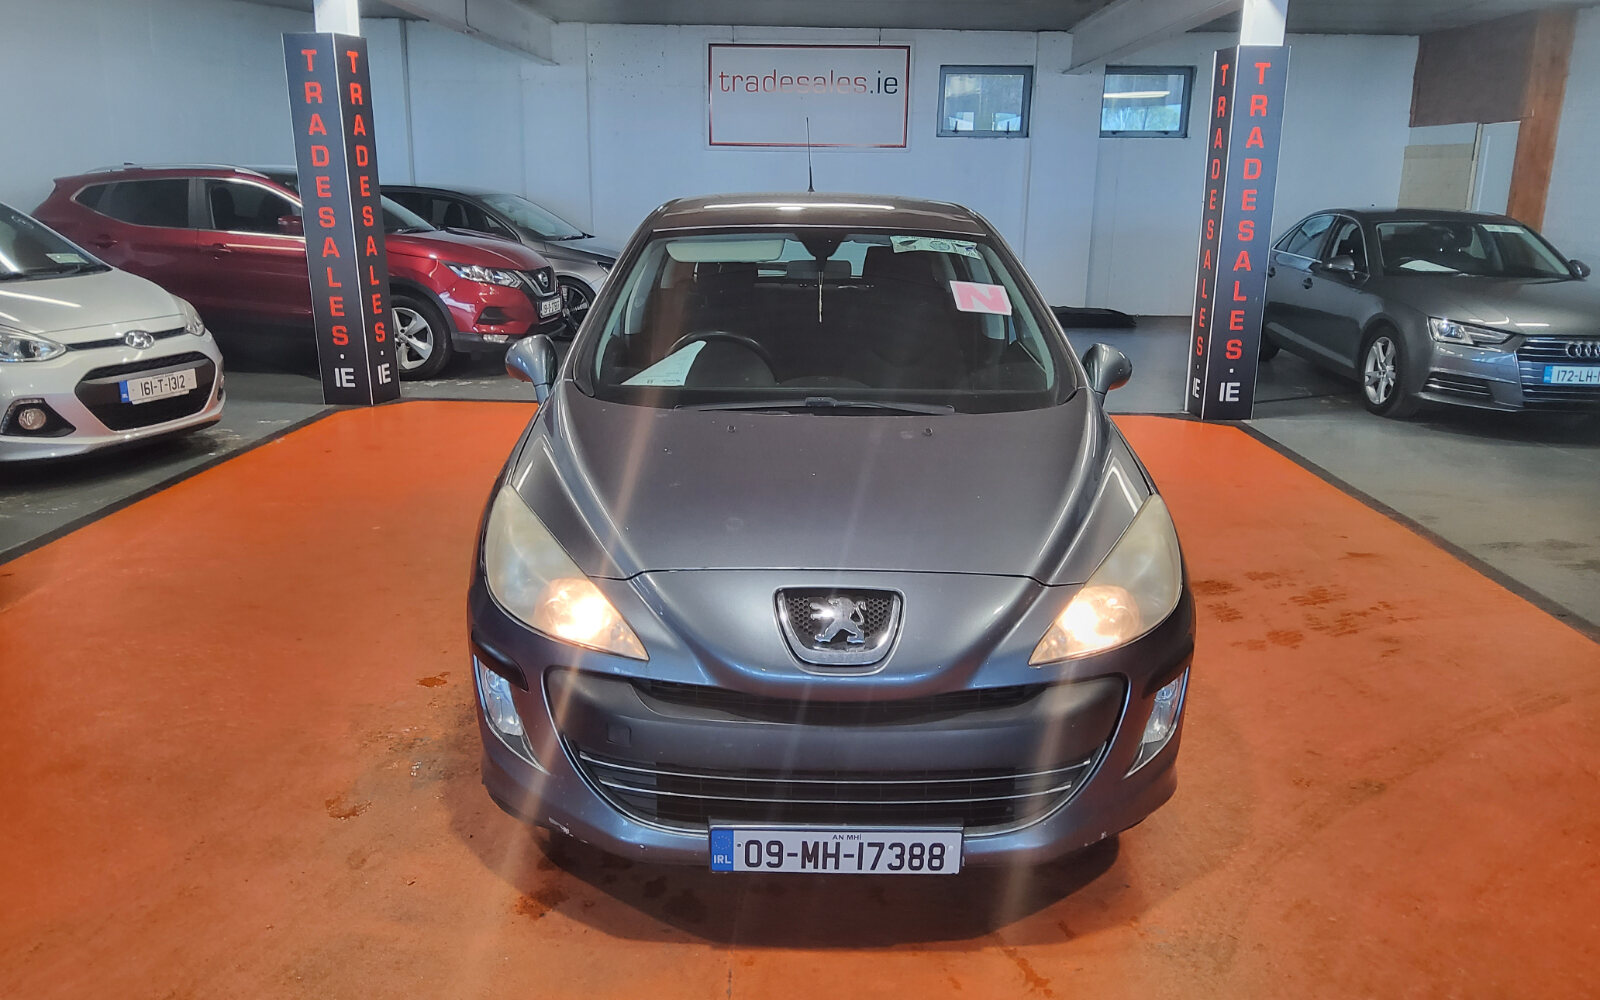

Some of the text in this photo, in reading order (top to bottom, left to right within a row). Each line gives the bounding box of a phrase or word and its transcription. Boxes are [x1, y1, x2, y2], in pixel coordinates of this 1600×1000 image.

[718, 69, 898, 95] tradesales.ie
[301, 49, 355, 388] TRADESALES.IE
[346, 51, 392, 385] TRADESALES.IE
[1192, 64, 1229, 398] TRADESALES.IE
[1219, 62, 1271, 402] TRADESALES.IE
[955, 283, 1007, 312] N
[140, 375, 186, 396] 161-T-1312
[713, 854, 732, 864] IRL
[744, 839, 946, 871] 09-MH-17388
